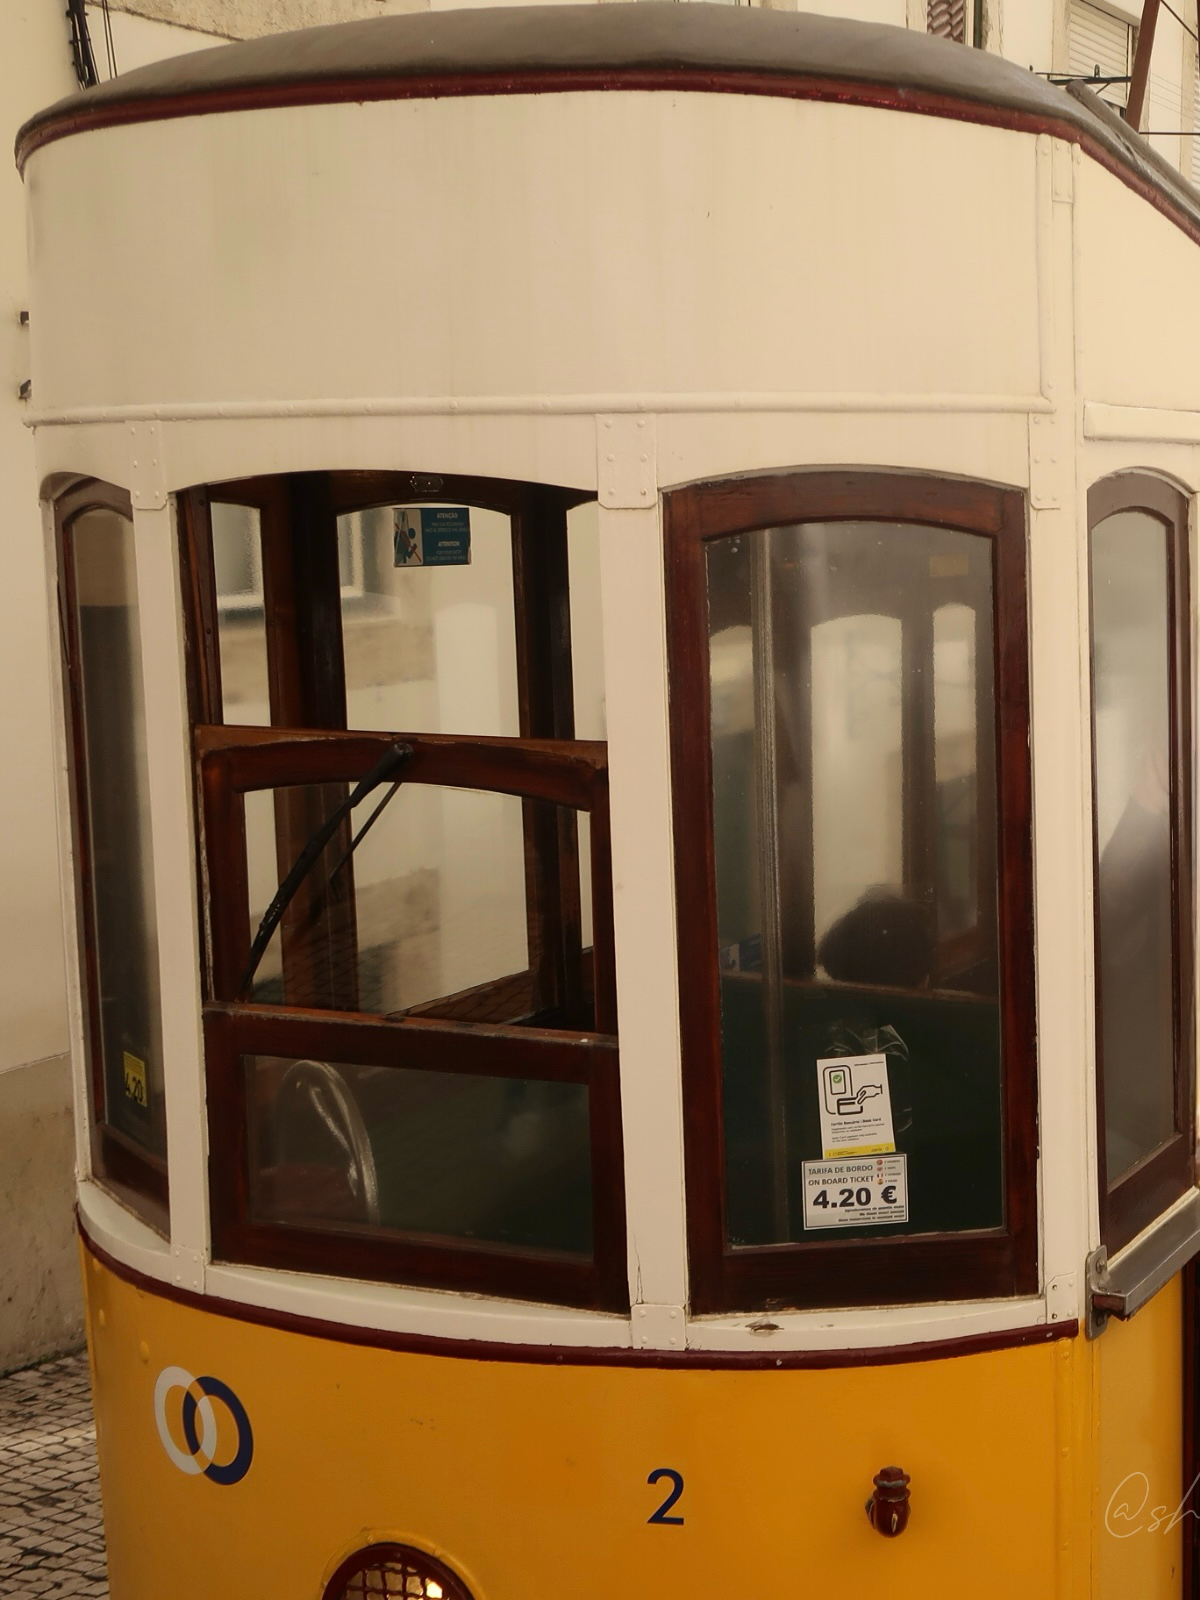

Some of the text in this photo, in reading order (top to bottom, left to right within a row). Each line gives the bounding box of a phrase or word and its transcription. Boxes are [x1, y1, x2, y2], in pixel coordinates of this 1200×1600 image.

[808, 1166, 833, 1175] TARIFA
[846, 1164, 873, 1172] BORDO
[822, 1177, 848, 1185] BOARD
[849, 1175, 874, 1183] TICKET
[813, 1185, 897, 1209] 4.20 €
[646, 1468, 684, 1526] 2
